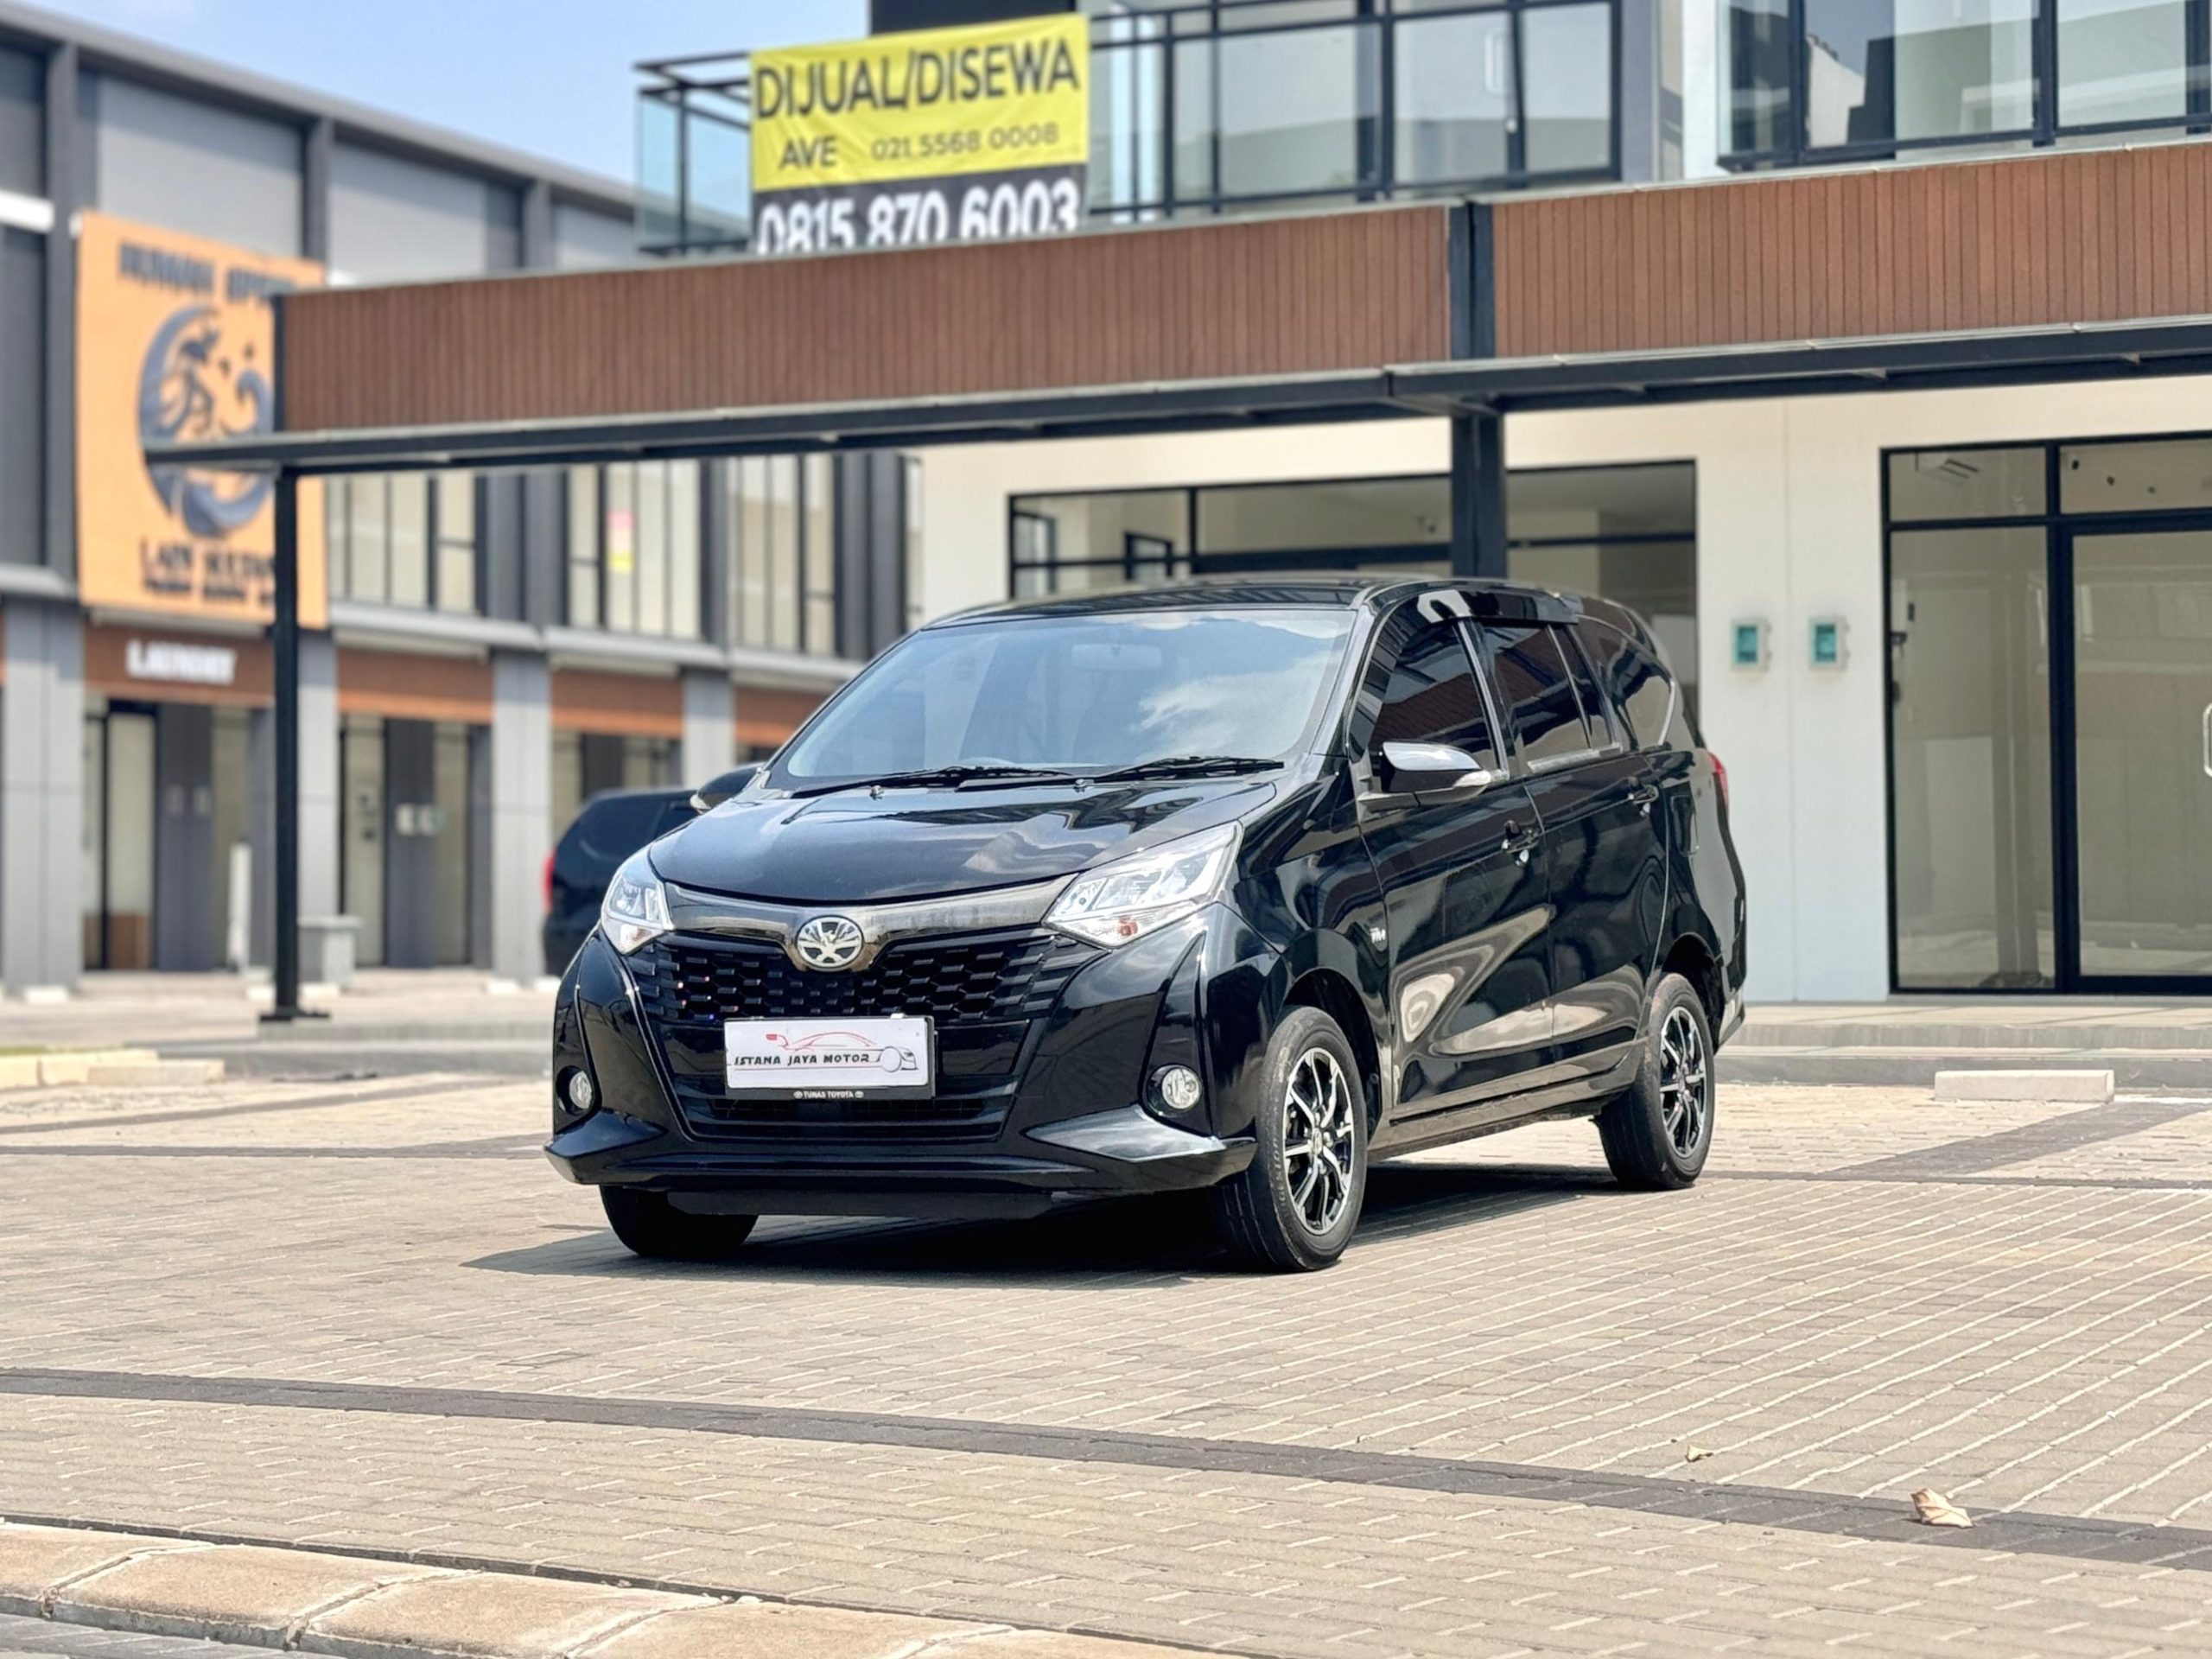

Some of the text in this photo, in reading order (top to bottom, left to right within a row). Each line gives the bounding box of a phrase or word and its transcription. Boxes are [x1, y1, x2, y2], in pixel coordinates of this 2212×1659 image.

[756, 39, 1079, 119] DIJUAL/DISEWA
[779, 137, 837, 169] AVE
[759, 178, 1079, 255] 0815 870 6003
[734, 1054, 869, 1065] ISTANA JAYA MOTOR
